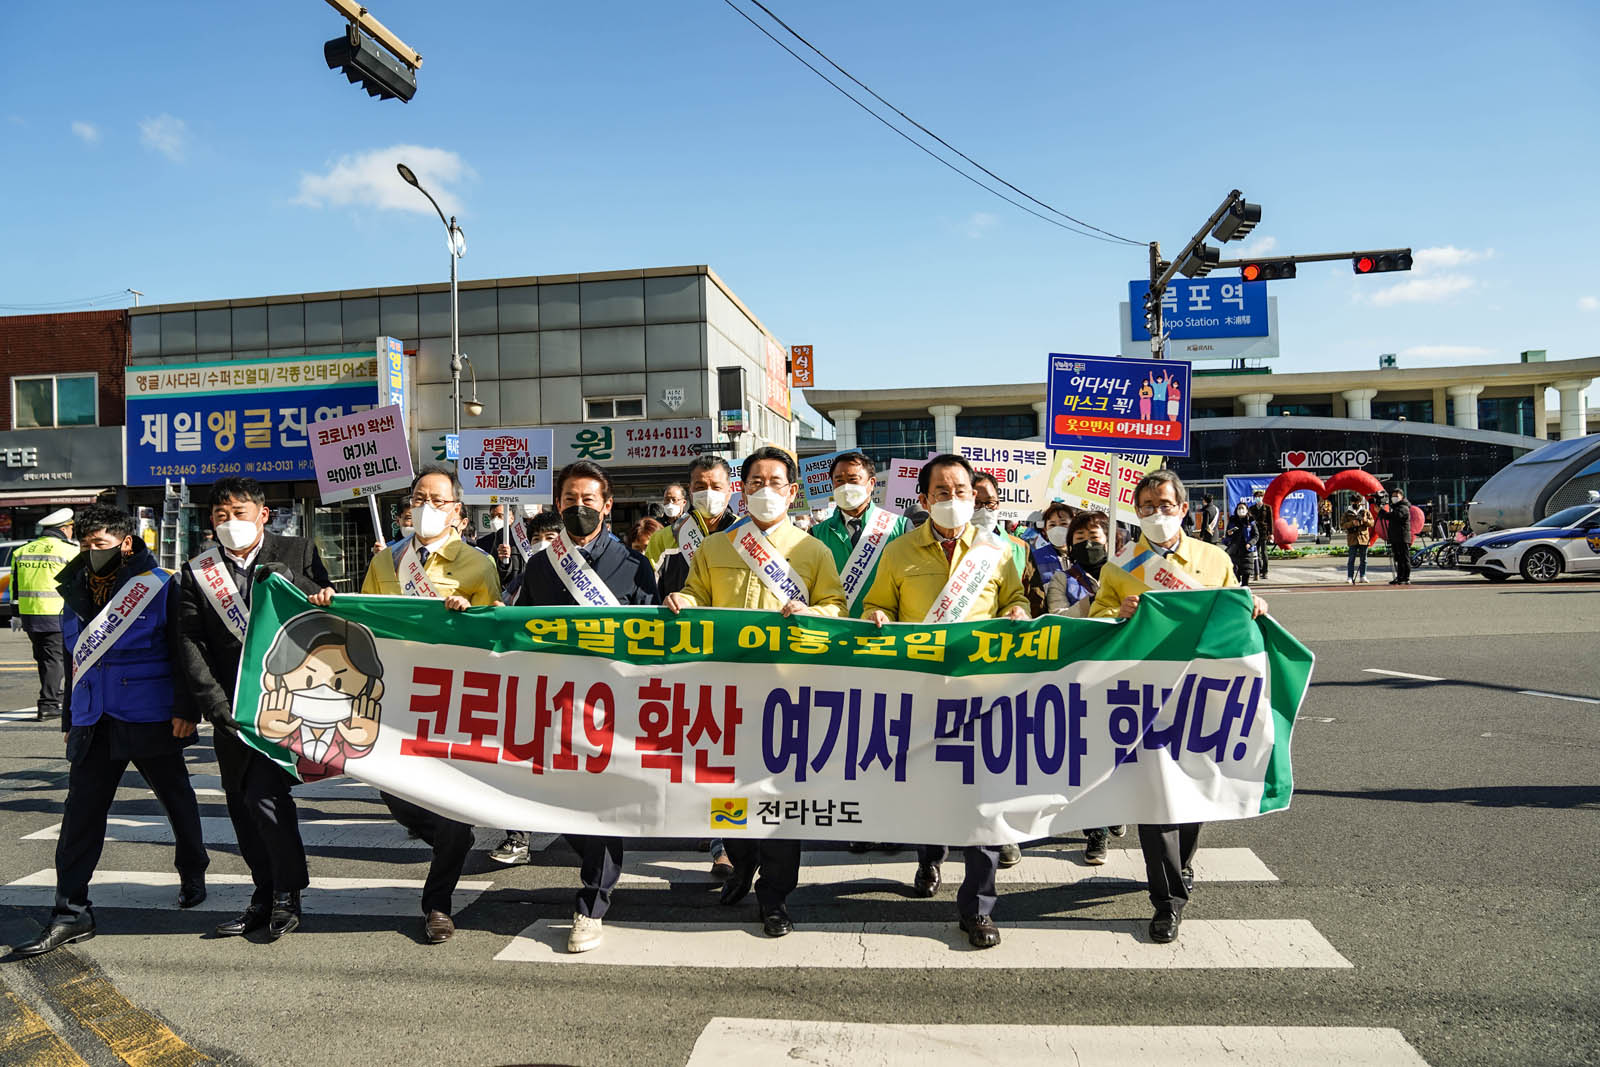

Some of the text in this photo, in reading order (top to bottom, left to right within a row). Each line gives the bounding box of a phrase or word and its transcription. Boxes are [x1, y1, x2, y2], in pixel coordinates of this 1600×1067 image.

[1185, 317, 1220, 327] Station
[1070, 376, 1131, 395] 어디서나
[1064, 395, 1134, 414] 마스크 꼭!
[318, 415, 395, 446] 코로나19 확산!
[1066, 419, 1171, 436] 웃으면서 이겨내요!
[343, 440, 378, 460] 여기서
[483, 438, 528, 452] 연말연시
[960, 446, 1047, 466] 코로나19 극복은
[1282, 451, 1369, 467] I MOKPO
[201, 462, 241, 475] 245-2460
[327, 456, 401, 484] 막아야 합니다.
[361, 484, 382, 494] 전라남도
[475, 475, 535, 489] 자제합시다!
[740, 532, 772, 567] 연말연시
[854, 542, 876, 569] 여기서
[114, 582, 150, 618] 연말연시
[215, 587, 234, 609] 확산
[525, 618, 1062, 663] 연말연시 이동·모임 자제
[400, 666, 1264, 786] 코로나19 확산 여기서 막아야 합니다!
[756, 799, 863, 827] 전라남도
